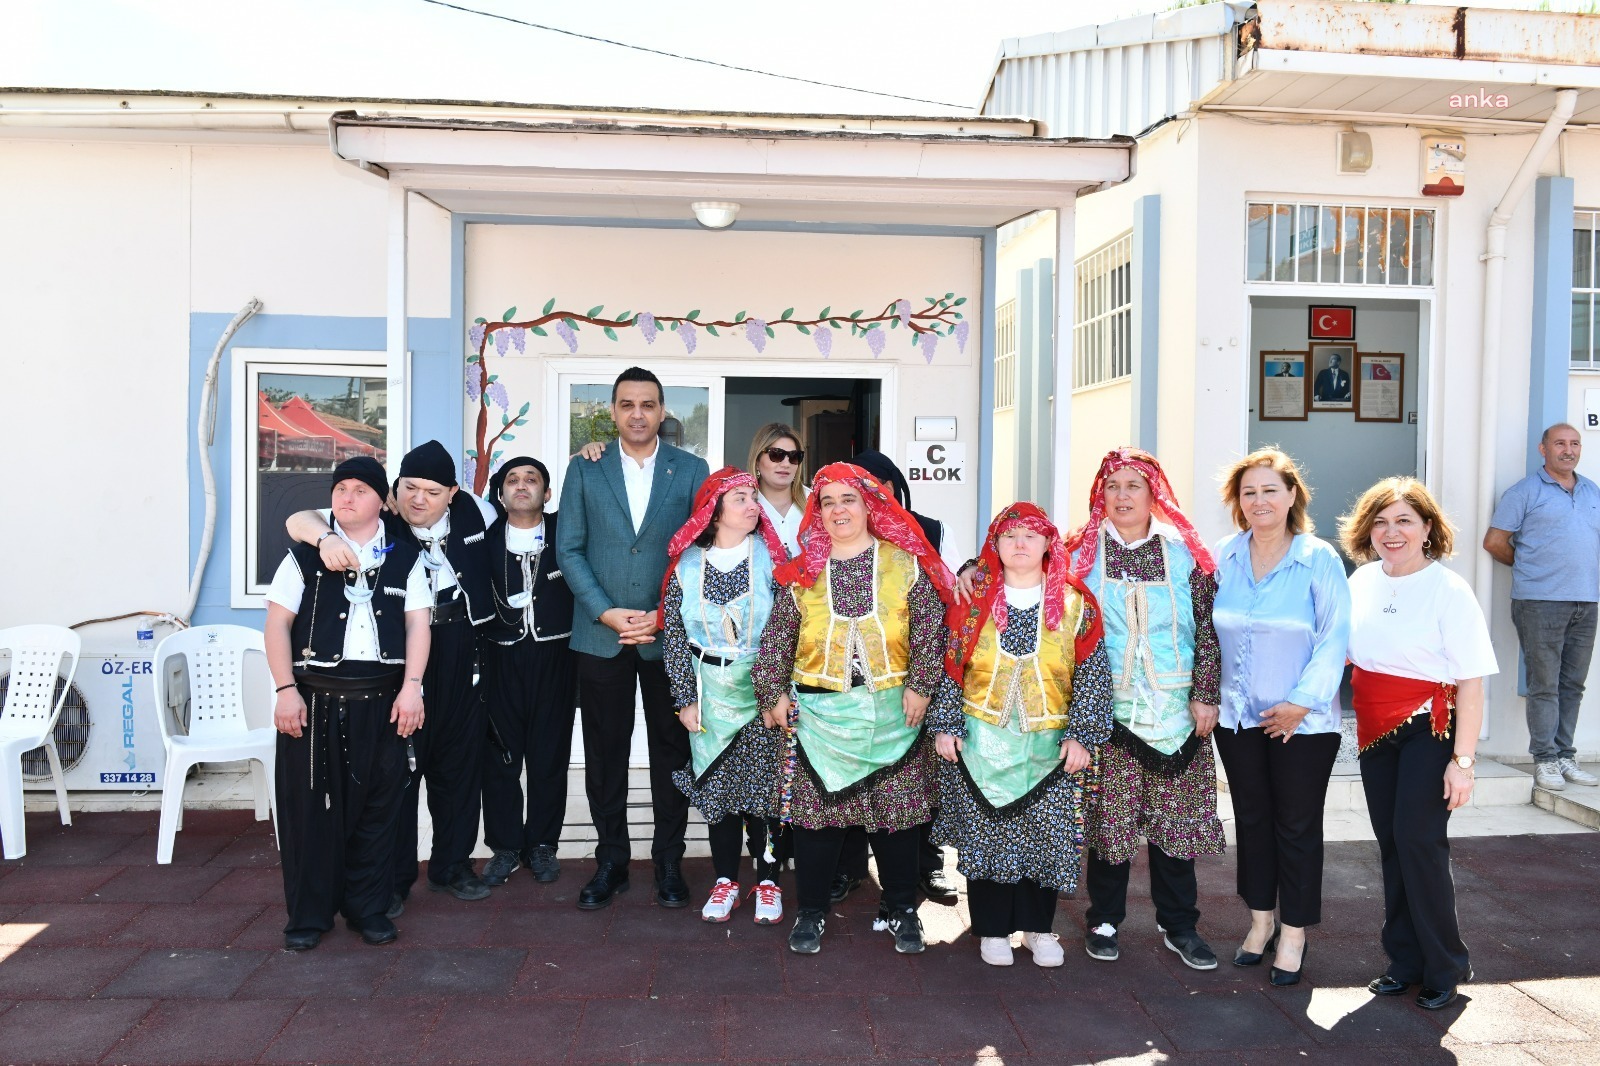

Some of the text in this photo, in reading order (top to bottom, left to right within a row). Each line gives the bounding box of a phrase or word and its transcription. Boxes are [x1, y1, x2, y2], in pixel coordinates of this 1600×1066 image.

[926, 444, 946, 465] C
[908, 467, 962, 481] BLOK
[122, 675, 134, 748] REGAL
[103, 773, 153, 783] 337 14 28
